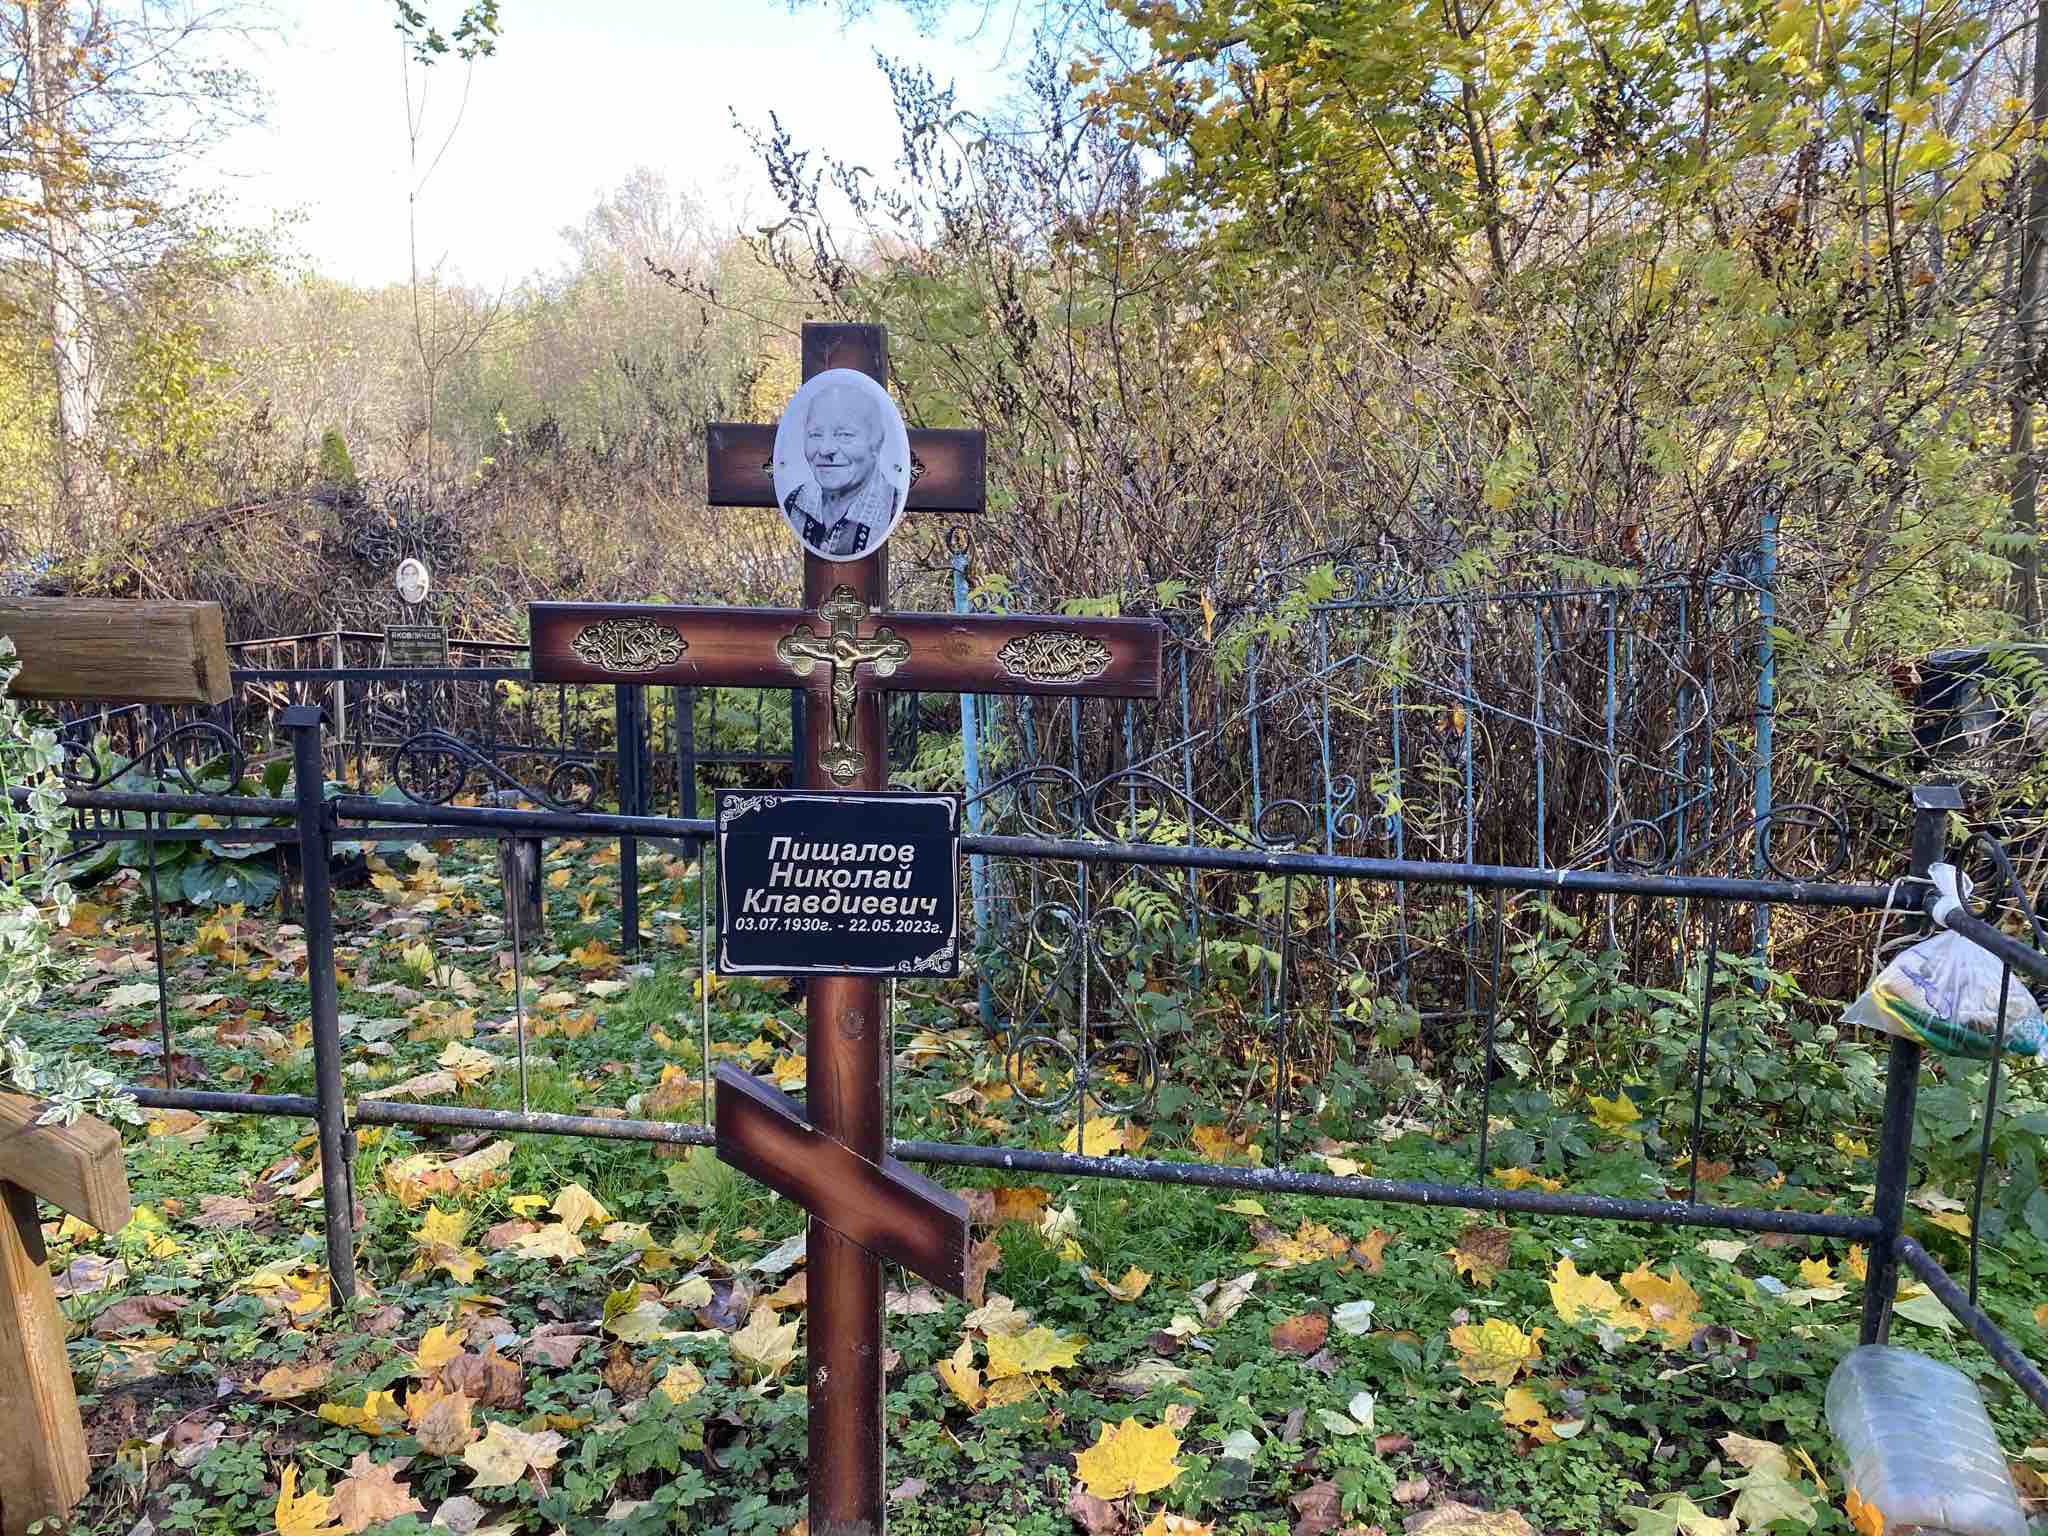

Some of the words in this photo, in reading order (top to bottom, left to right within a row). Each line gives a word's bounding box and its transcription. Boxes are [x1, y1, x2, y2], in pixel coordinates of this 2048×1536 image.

[768, 836, 915, 865] Пищалов
[768, 862, 913, 889] Николай
[742, 888, 938, 916] Клавдиевич
[735, 917, 833, 932] 03.07.1930г.
[848, 918, 943, 934] 22.05.2023г.
